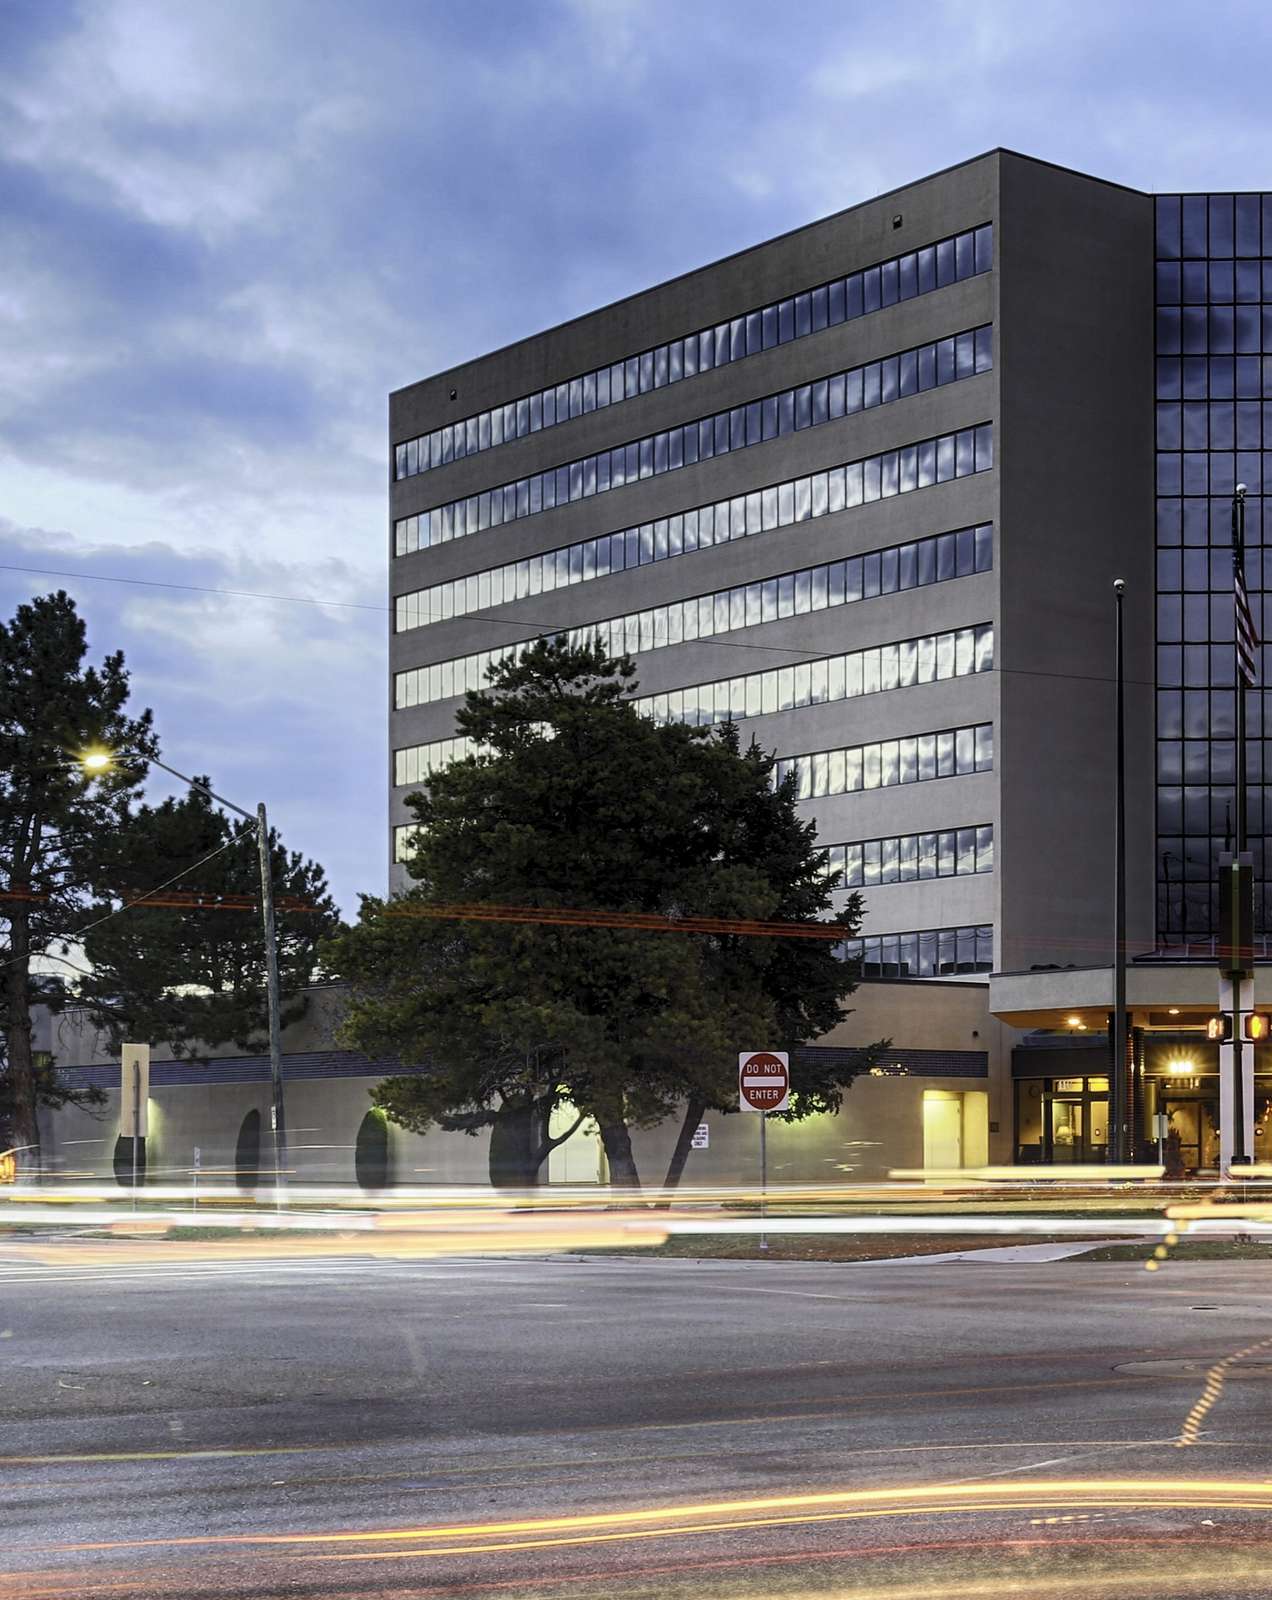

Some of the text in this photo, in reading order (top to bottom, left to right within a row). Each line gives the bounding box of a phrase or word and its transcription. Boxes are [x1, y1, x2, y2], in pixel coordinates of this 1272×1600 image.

[746, 1064, 782, 1074] DO NOT
[750, 1090, 779, 1100] ENTER
